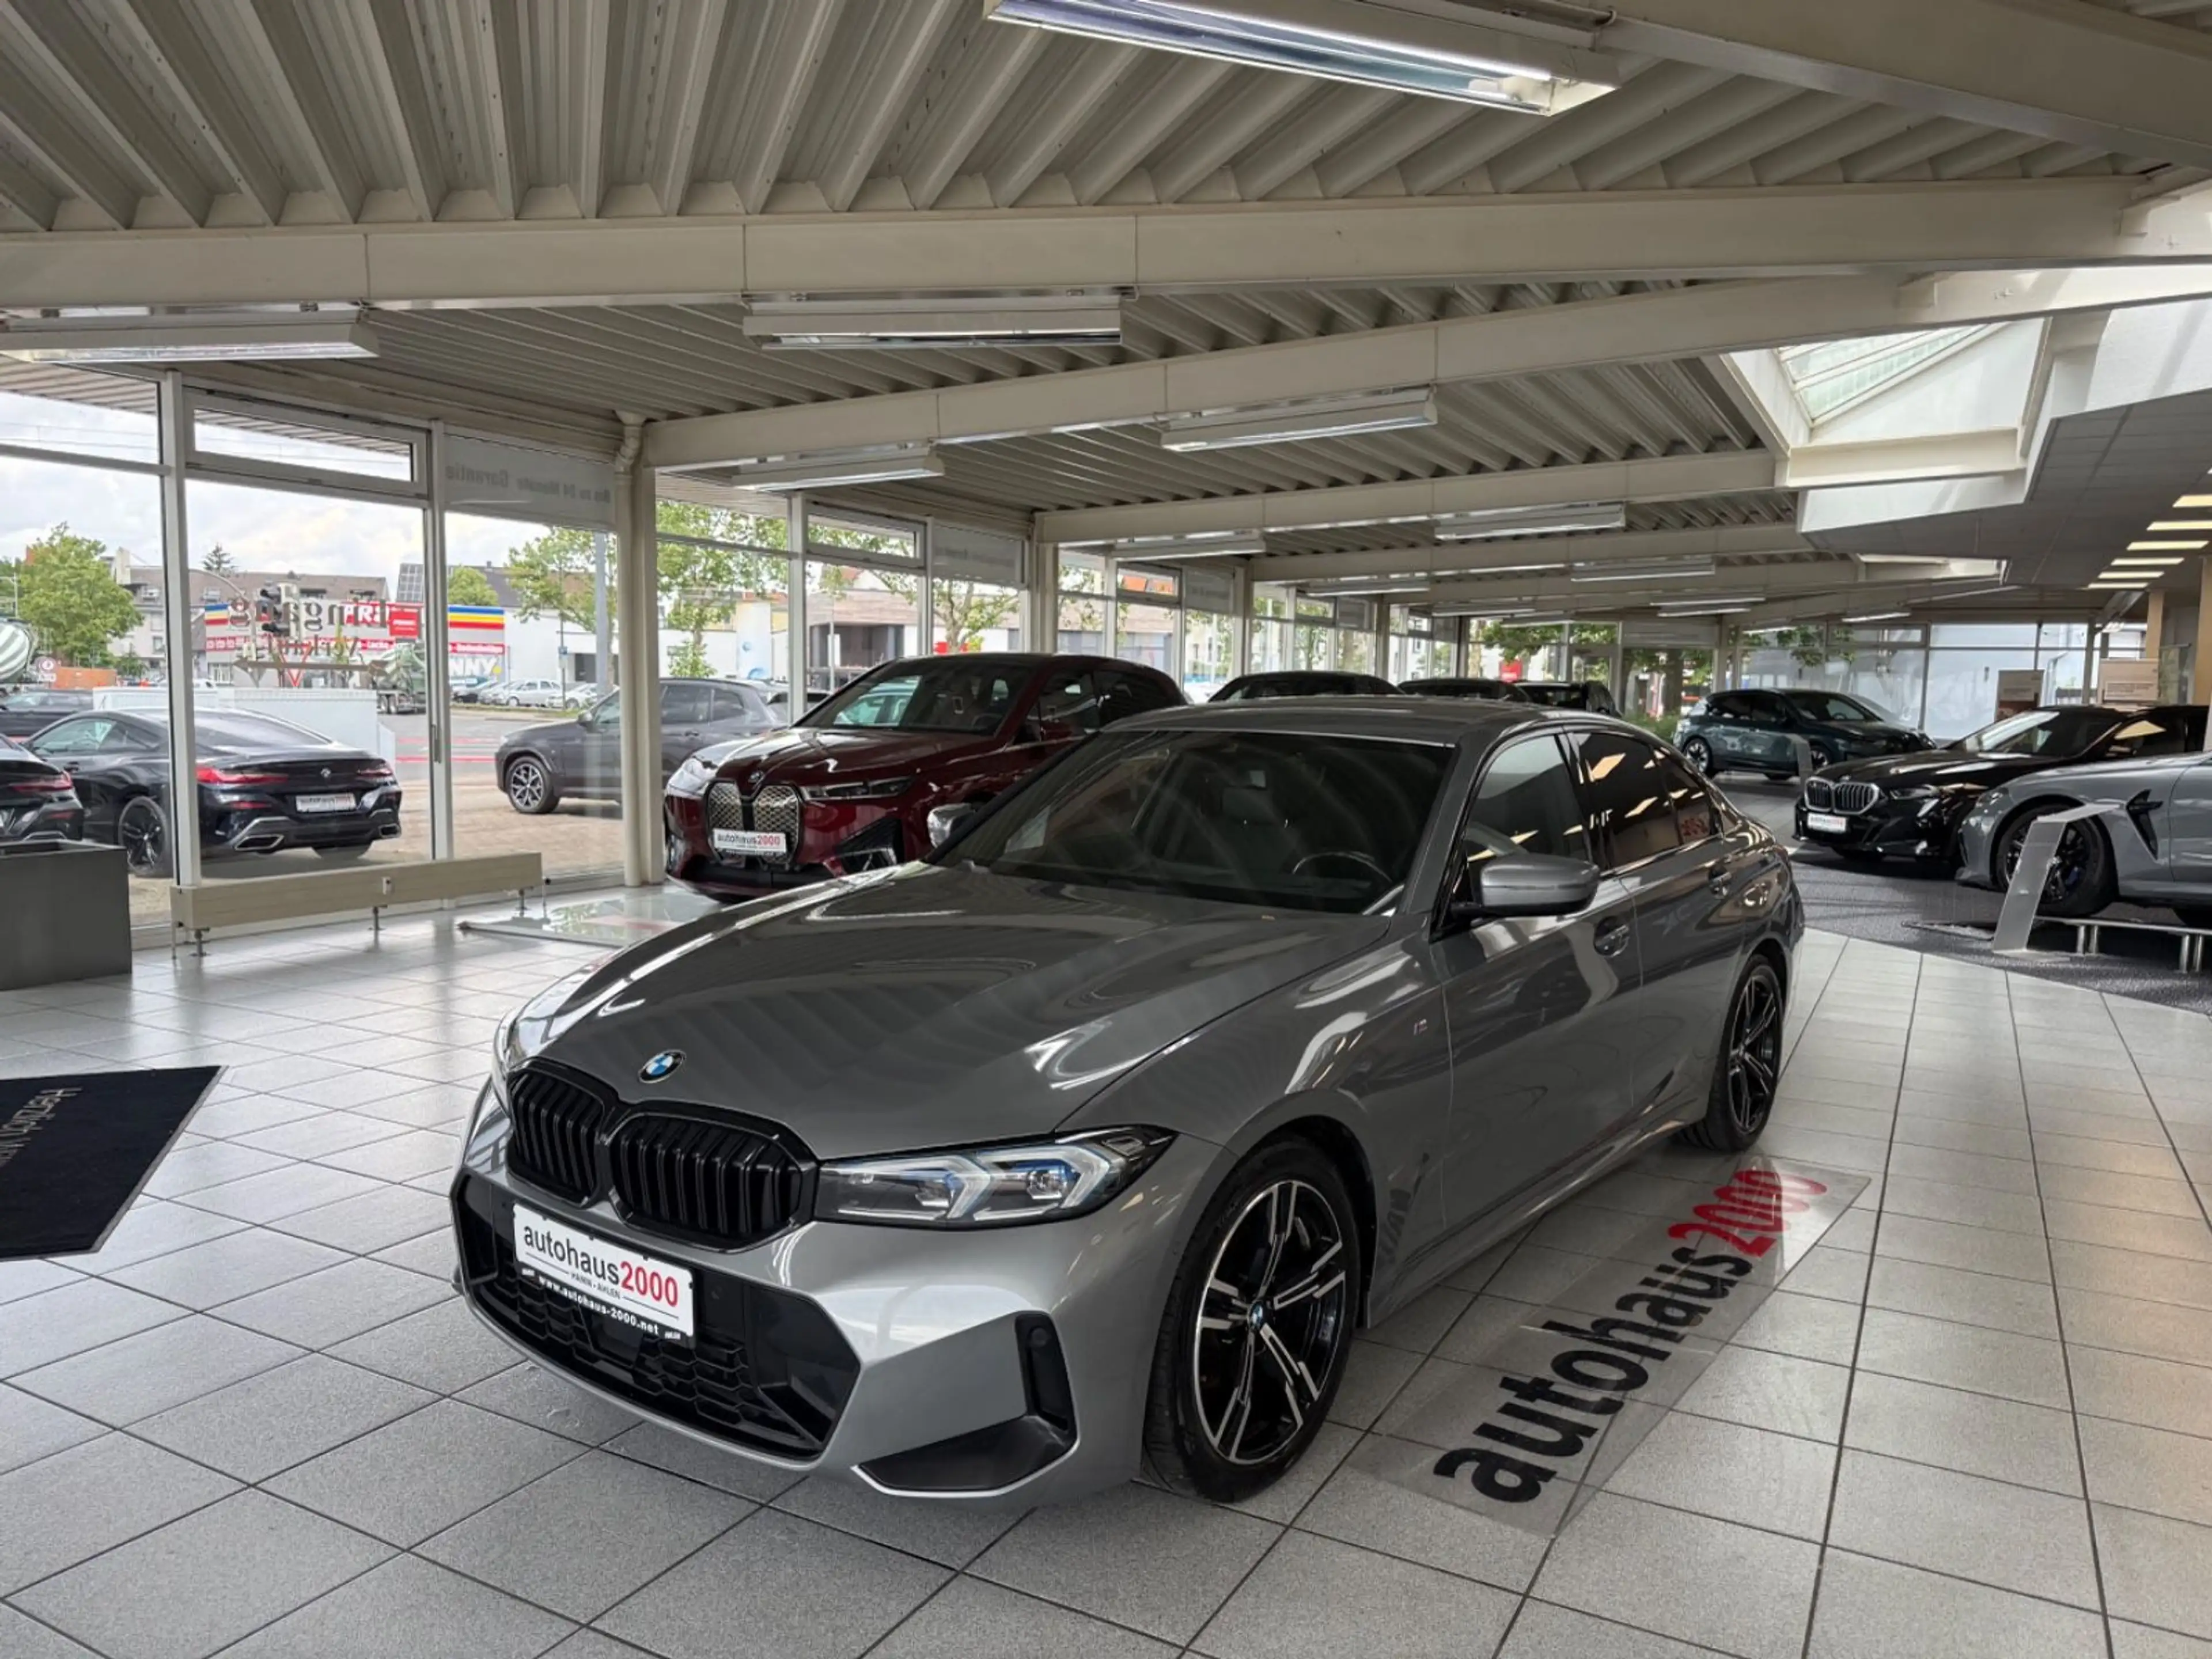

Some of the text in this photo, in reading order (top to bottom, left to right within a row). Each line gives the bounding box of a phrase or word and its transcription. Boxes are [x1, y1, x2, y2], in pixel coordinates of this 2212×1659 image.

[524, 1225, 678, 1308] autohaus2000
[538, 1274, 660, 1336] www.autohaus-2000.net
[1433, 1167, 1827, 1503] autohaus2000
